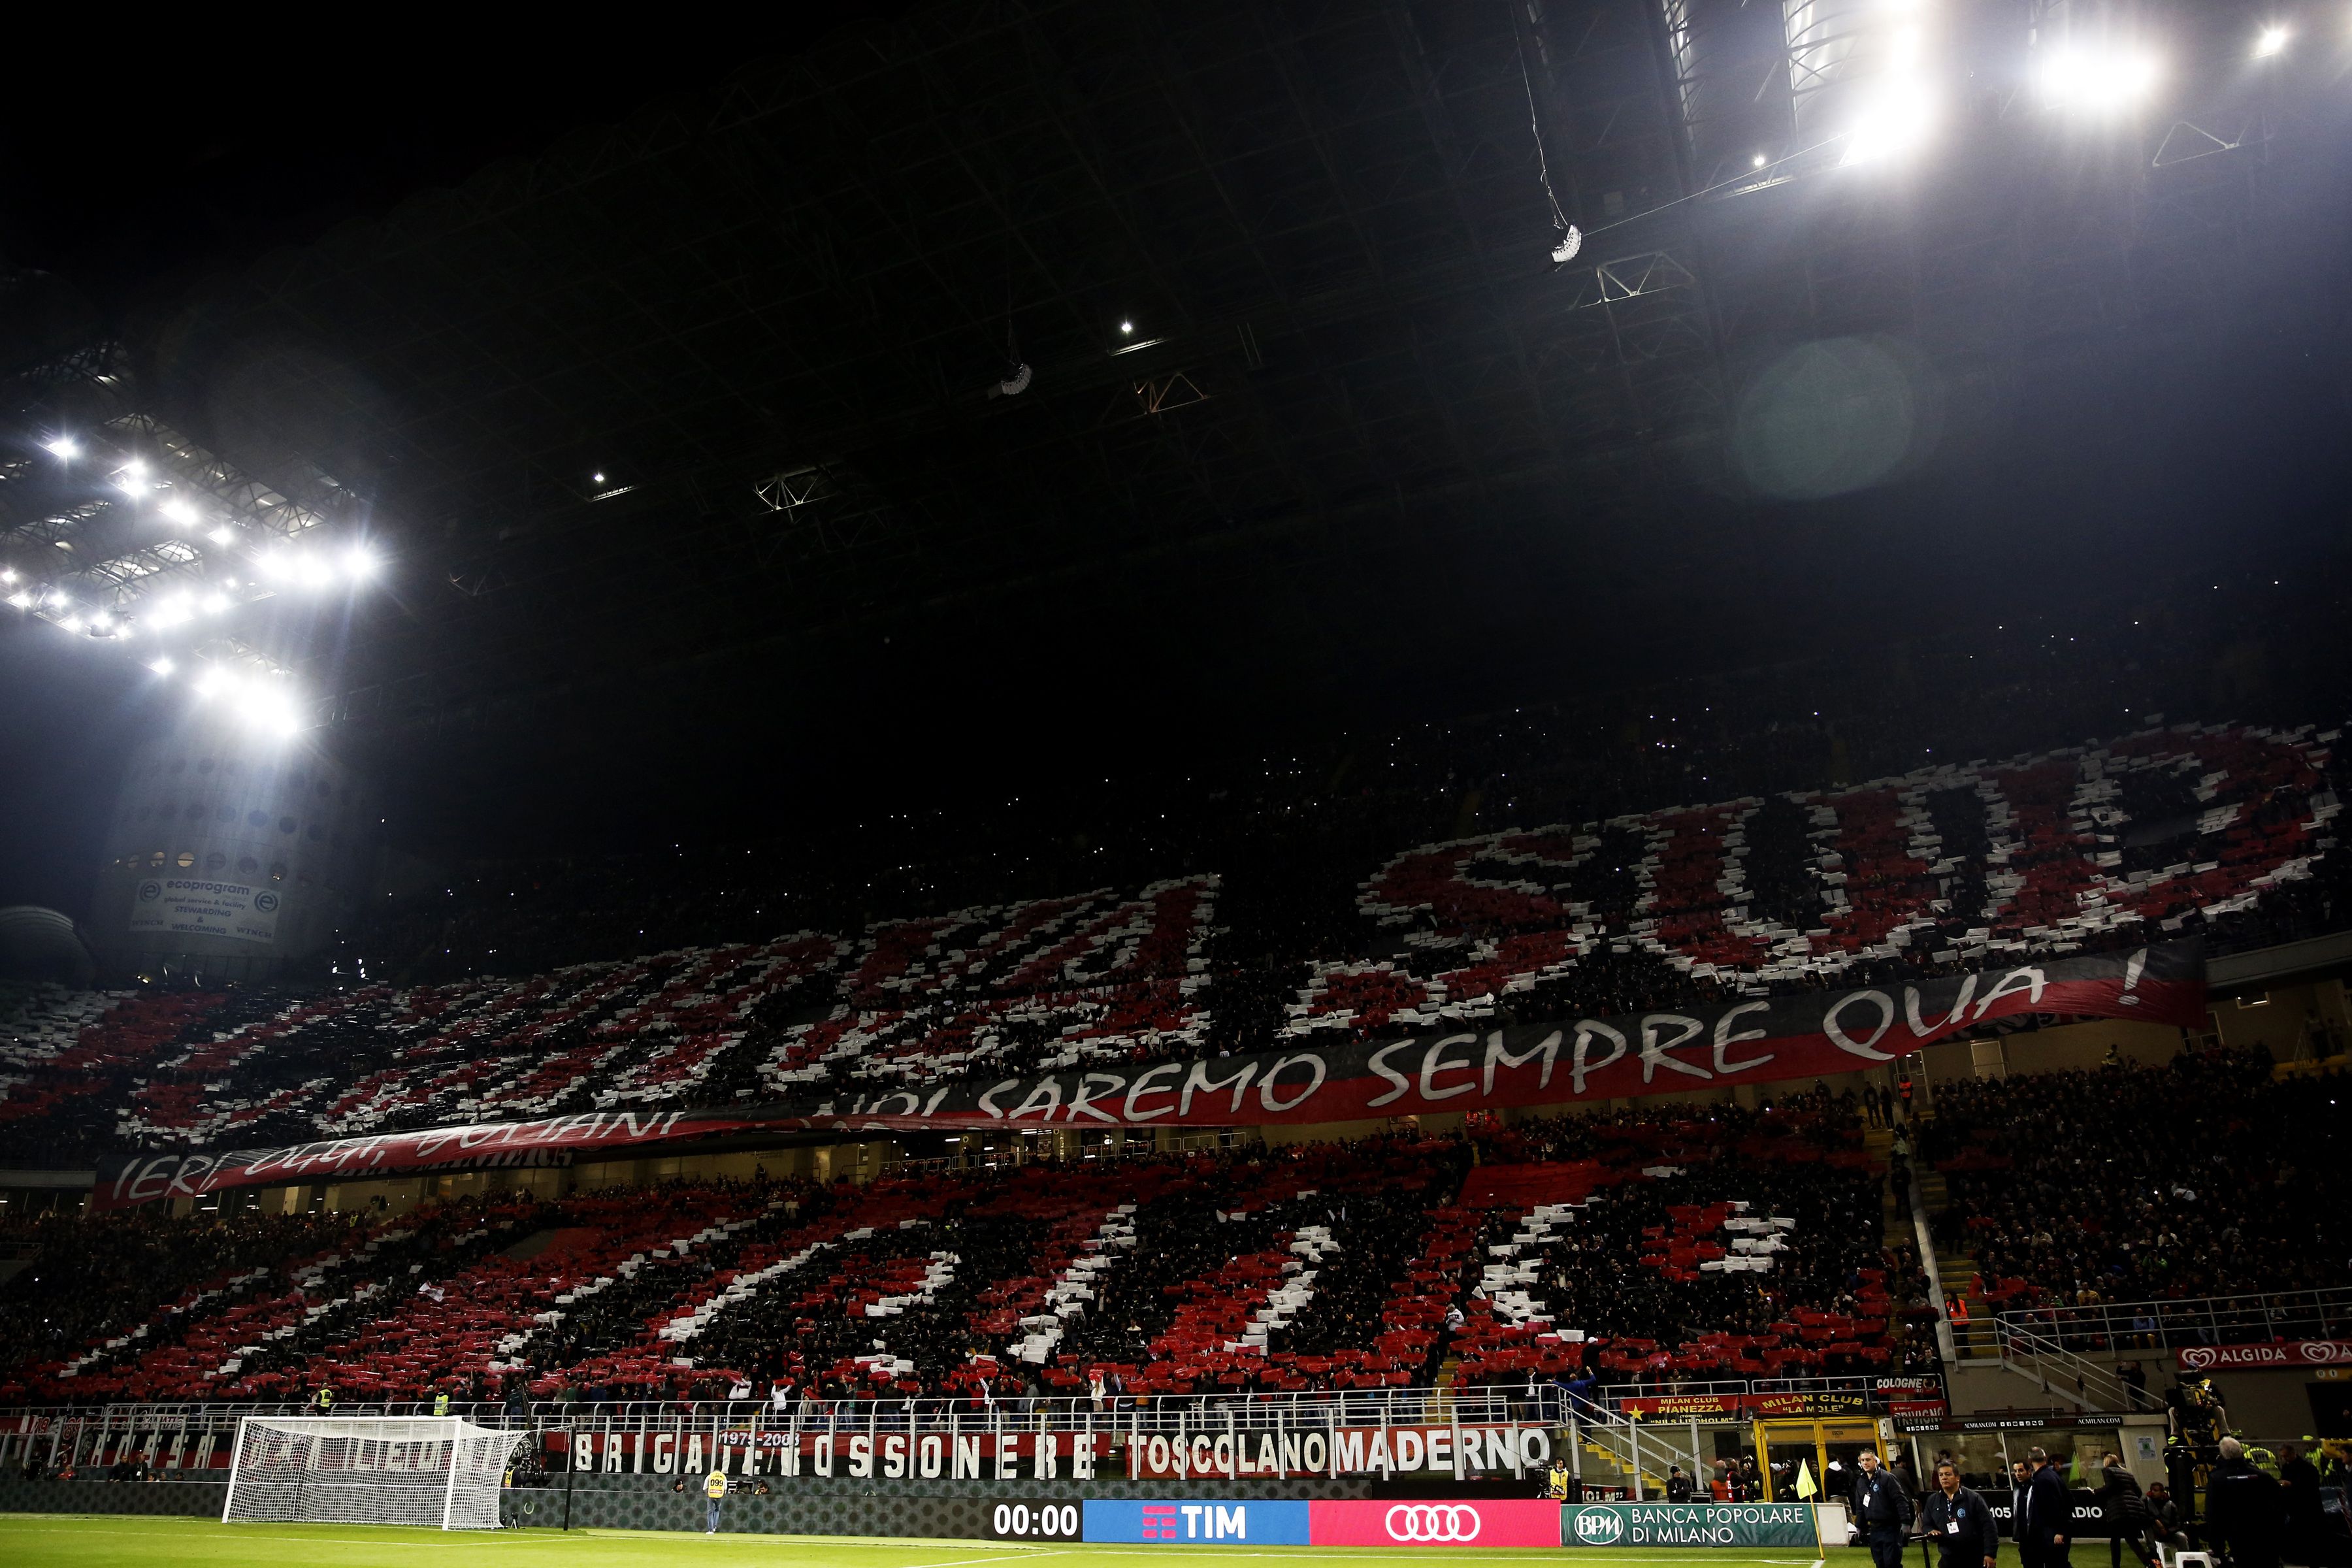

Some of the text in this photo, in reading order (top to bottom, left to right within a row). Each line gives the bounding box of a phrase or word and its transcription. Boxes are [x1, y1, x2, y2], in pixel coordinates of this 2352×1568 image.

[167, 880, 250, 895] ecoprogram
[174, 906, 232, 917] STEWARDING
[171, 923, 227, 934] WELCOMING
[977, 1053, 1327, 1123] SAREMO
[1365, 1000, 1772, 1108] SEMPRE
[1823, 966, 2048, 1060] QUA
[2221, 1347, 2287, 1363] ALGIDA
[1876, 1377, 1923, 1389] COLOGNE
[1658, 1405, 1724, 1414] PIANEZZA
[1762, 1394, 1863, 1409] MILAN CLUB
[2078, 1416, 2121, 1425] ACMILAN.COM
[1128, 1428, 1550, 1474] TOSCOLANO MADERNO
[993, 1503, 1079, 1537] 00:00
[1181, 1505, 1247, 1540] TIM
[1631, 1507, 1805, 1524] BANCA POPOLARE
[1578, 1515, 1620, 1535] BPM
[1633, 1527, 1735, 1544] DI MILANO
